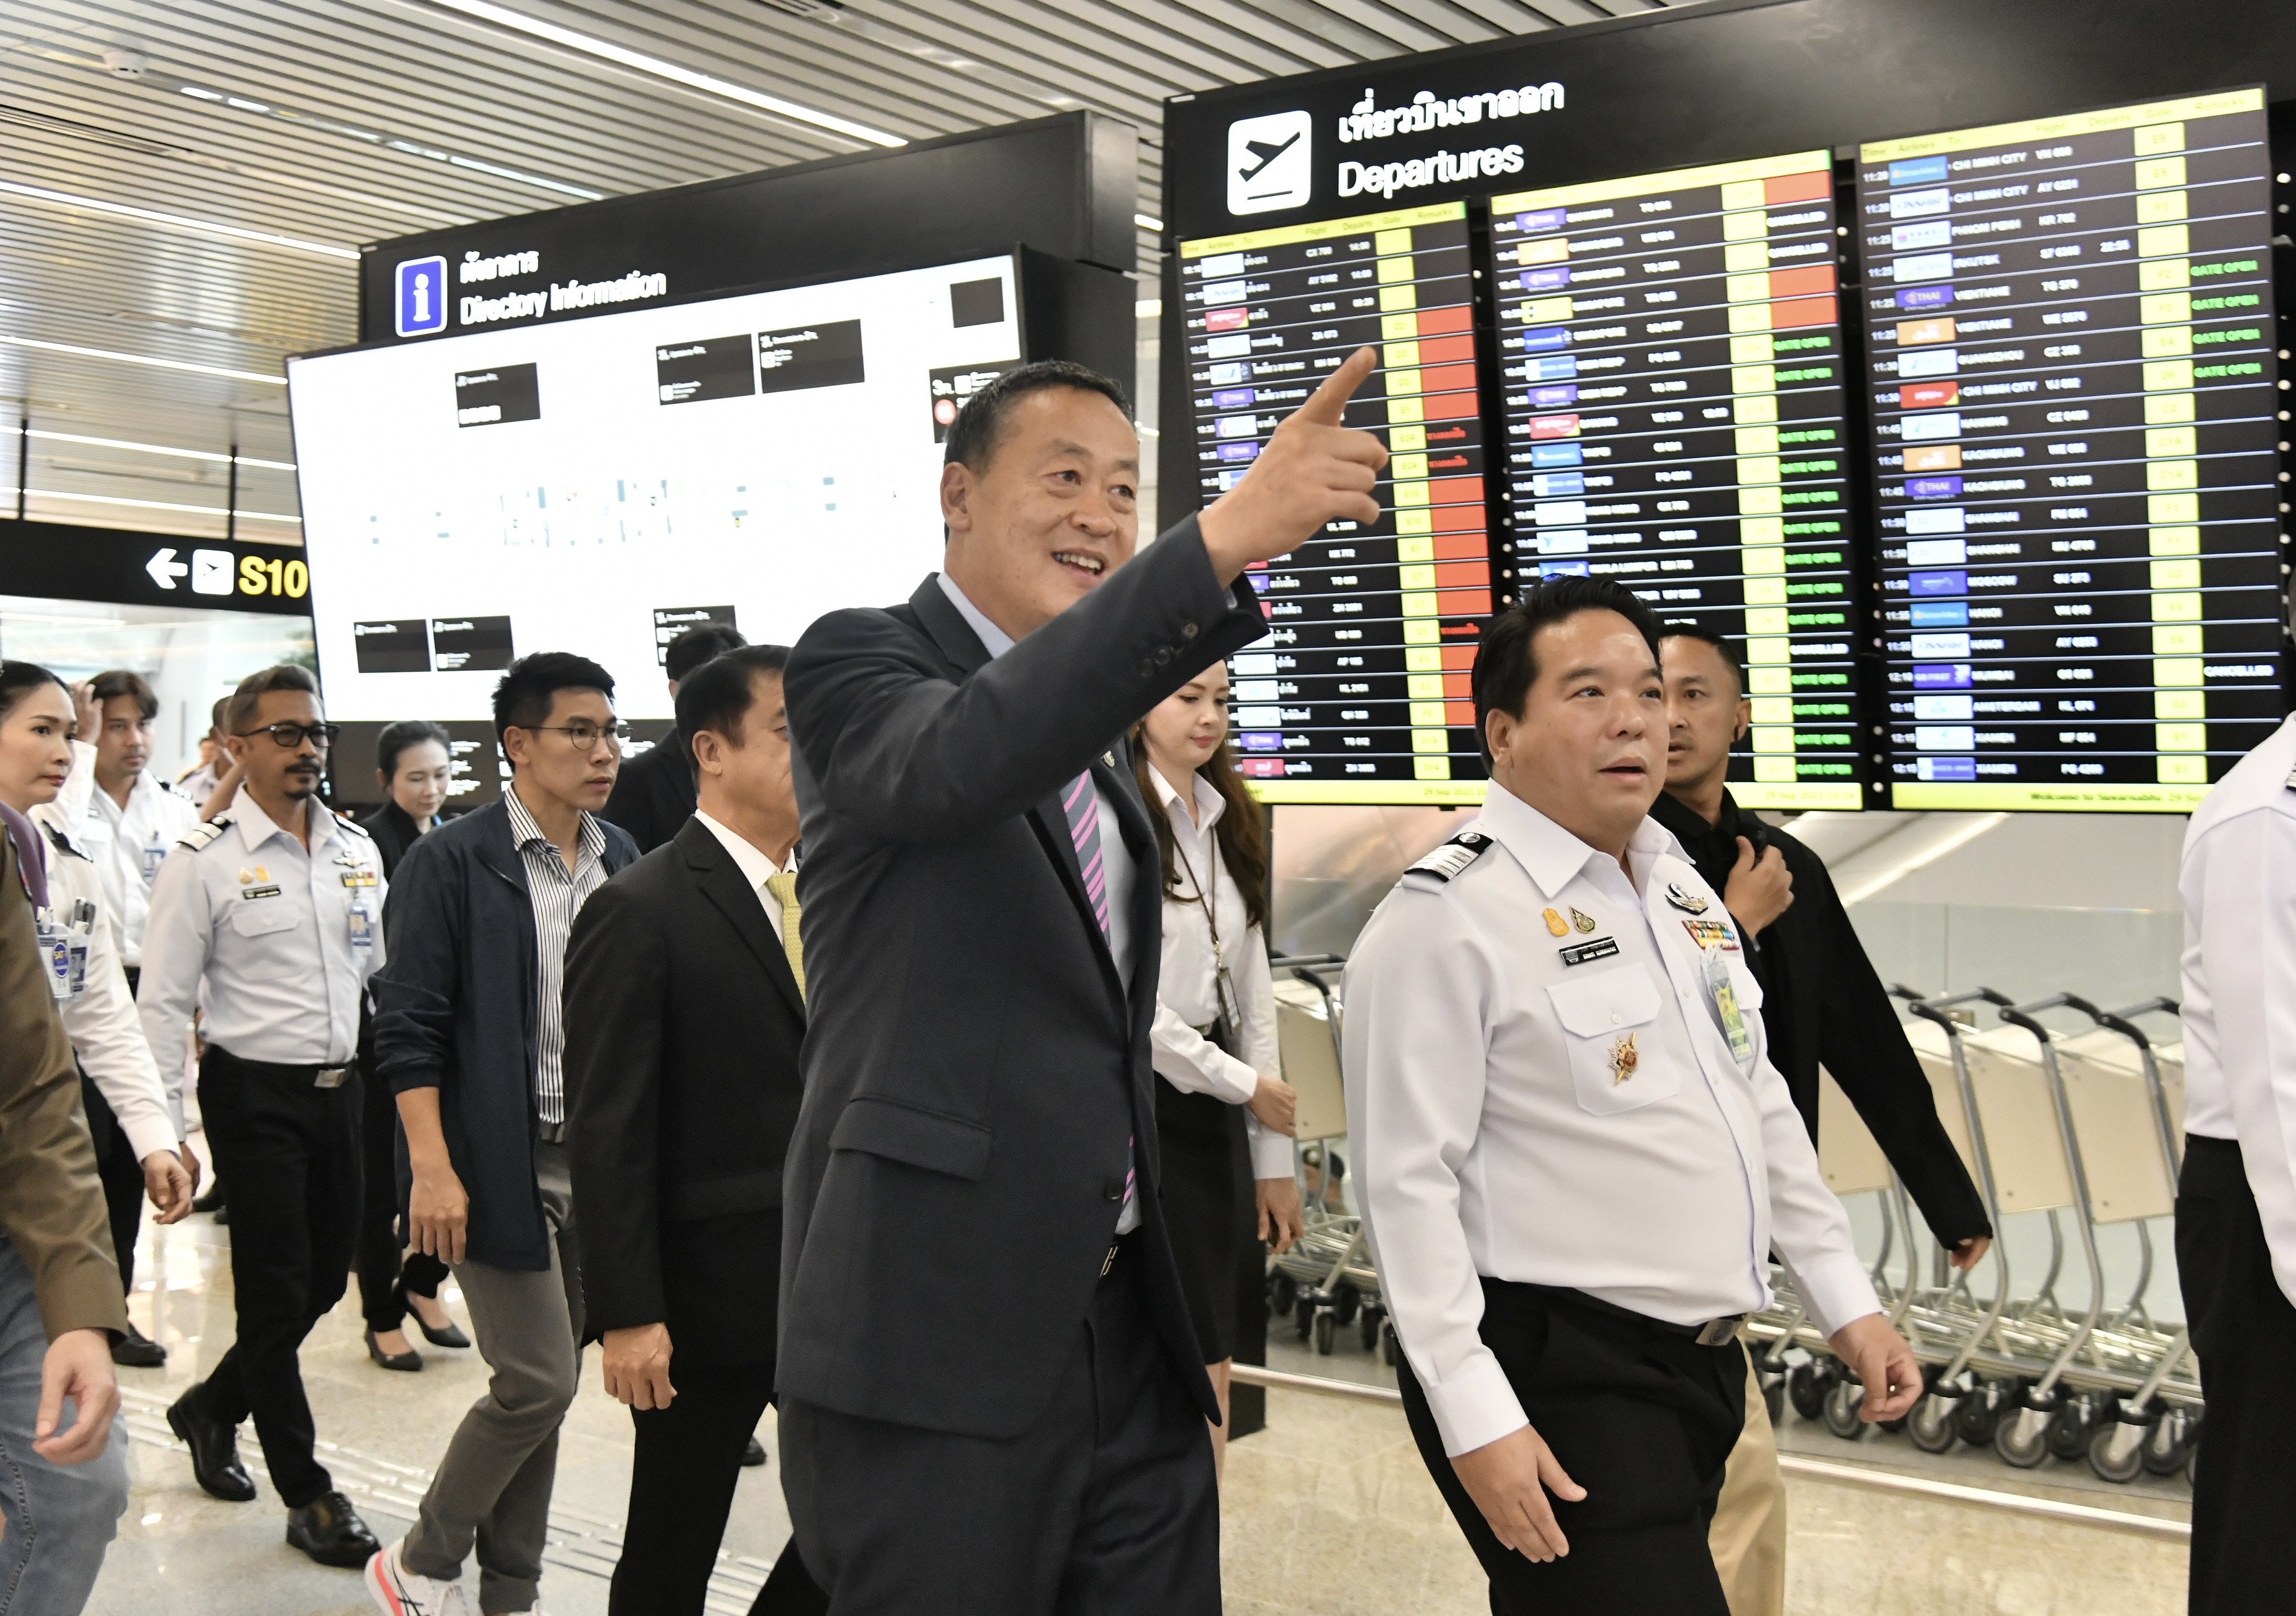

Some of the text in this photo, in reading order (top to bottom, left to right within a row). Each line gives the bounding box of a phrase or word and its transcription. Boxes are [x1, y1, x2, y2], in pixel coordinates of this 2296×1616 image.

[1339, 82, 1565, 143] เที่ยวบินขาออก
[1862, 98, 2246, 157] Time Airlines To Flight Departs Gate Remarks
[2001, 152, 2028, 164] CITY
[1338, 144, 1524, 199] Departures
[2002, 185, 2029, 197] CITY
[2037, 181, 2053, 193] AY
[1305, 226, 1327, 236] Flight
[1342, 220, 1373, 232] Departs
[1382, 216, 1402, 225] Gate
[1416, 208, 1454, 220] Remarks
[2190, 264, 2223, 276] GATE
[2224, 260, 2258, 273] OPEN
[460, 270, 667, 325] Directory Information
[2191, 298, 2224, 310] GATE
[2225, 294, 2259, 307] OPEN
[1773, 336, 1830, 351] GATE OPEN
[2193, 332, 2226, 344] GATE
[2226, 329, 2261, 341] OPEN
[1774, 368, 1832, 381] GATE OPEN
[2194, 365, 2227, 378] GATE
[2227, 362, 2262, 375] OPEN
[2011, 380, 2038, 392] CITY
[1778, 429, 1835, 444] GATE OPEN
[1780, 460, 1837, 474] GATE OPEN
[1781, 491, 1839, 504] GATE OPEN
[238, 555, 309, 598] S10
[2204, 665, 2274, 677] CANCELLED
[2030, 792, 2079, 801] Welcome
